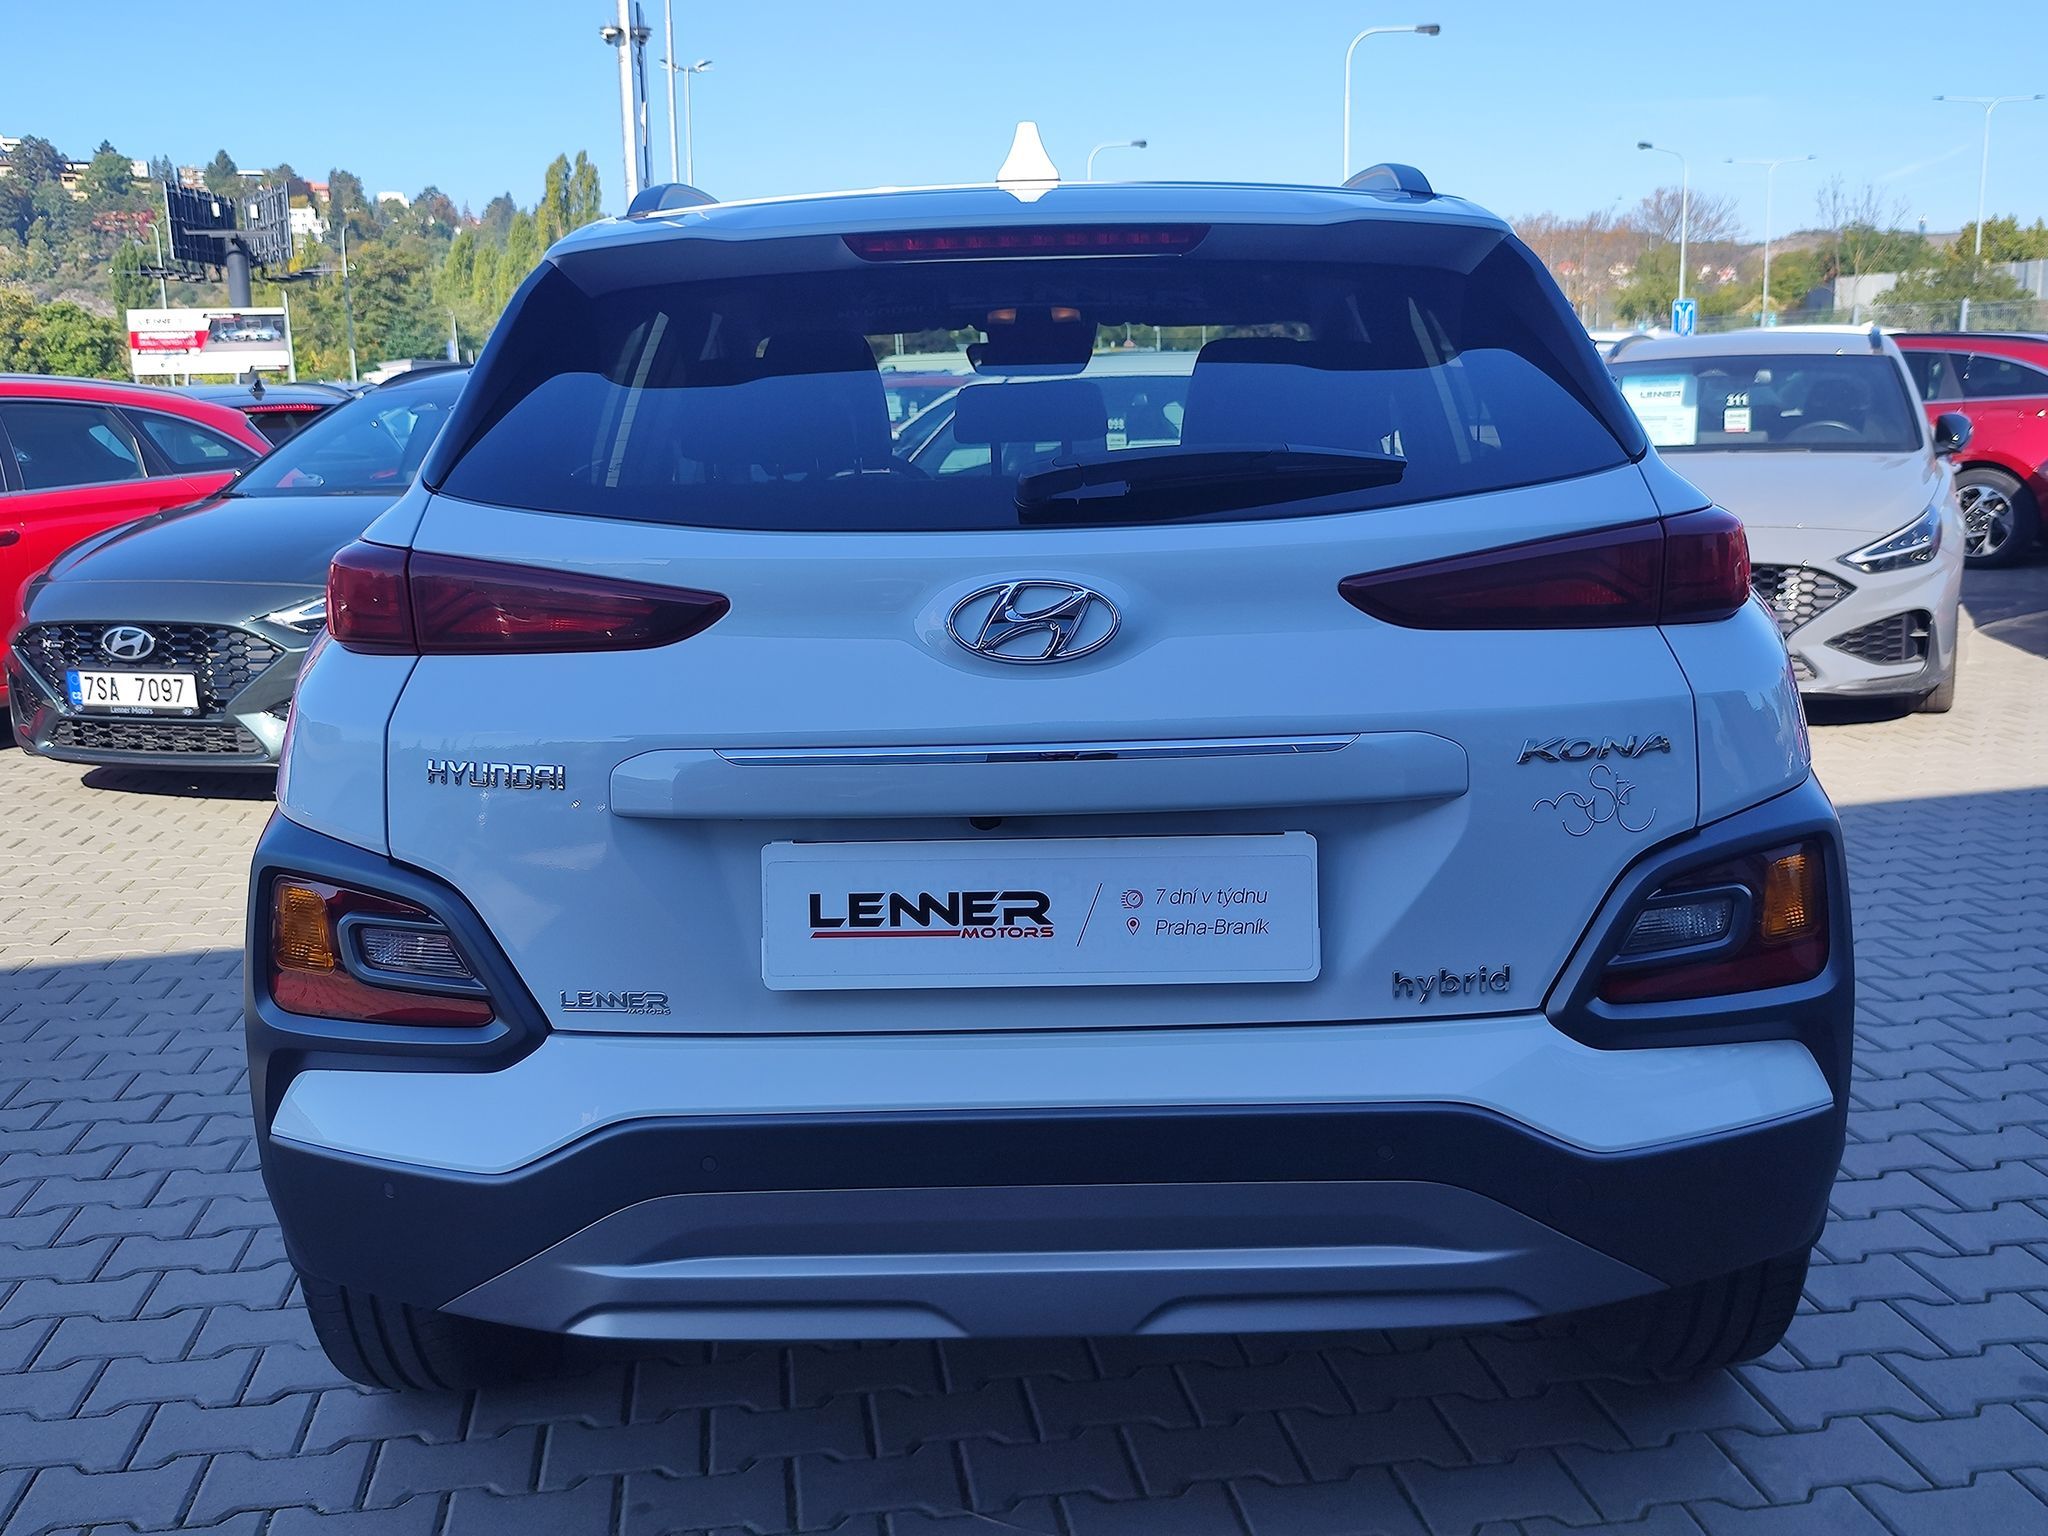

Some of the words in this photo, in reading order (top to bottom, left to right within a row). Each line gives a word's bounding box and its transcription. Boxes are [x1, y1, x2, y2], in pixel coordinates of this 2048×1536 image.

[84, 676, 120, 701] 7SA
[134, 677, 184, 703] 7097
[110, 706, 131, 715] Lenner
[131, 706, 154, 715] Motors
[1516, 732, 1671, 765] KONA
[427, 758, 566, 790] HYUNDAI
[1155, 888, 1167, 905] 7
[1169, 887, 1199, 905] dní
[1201, 891, 1213, 904] v
[1217, 886, 1268, 908] týdnu
[808, 891, 1055, 928] LENNER
[961, 926, 1055, 940] MOTORS
[1155, 917, 1271, 936] Praha-Braník
[1392, 963, 1511, 1004] hybrid
[560, 990, 670, 1009] LENNER
